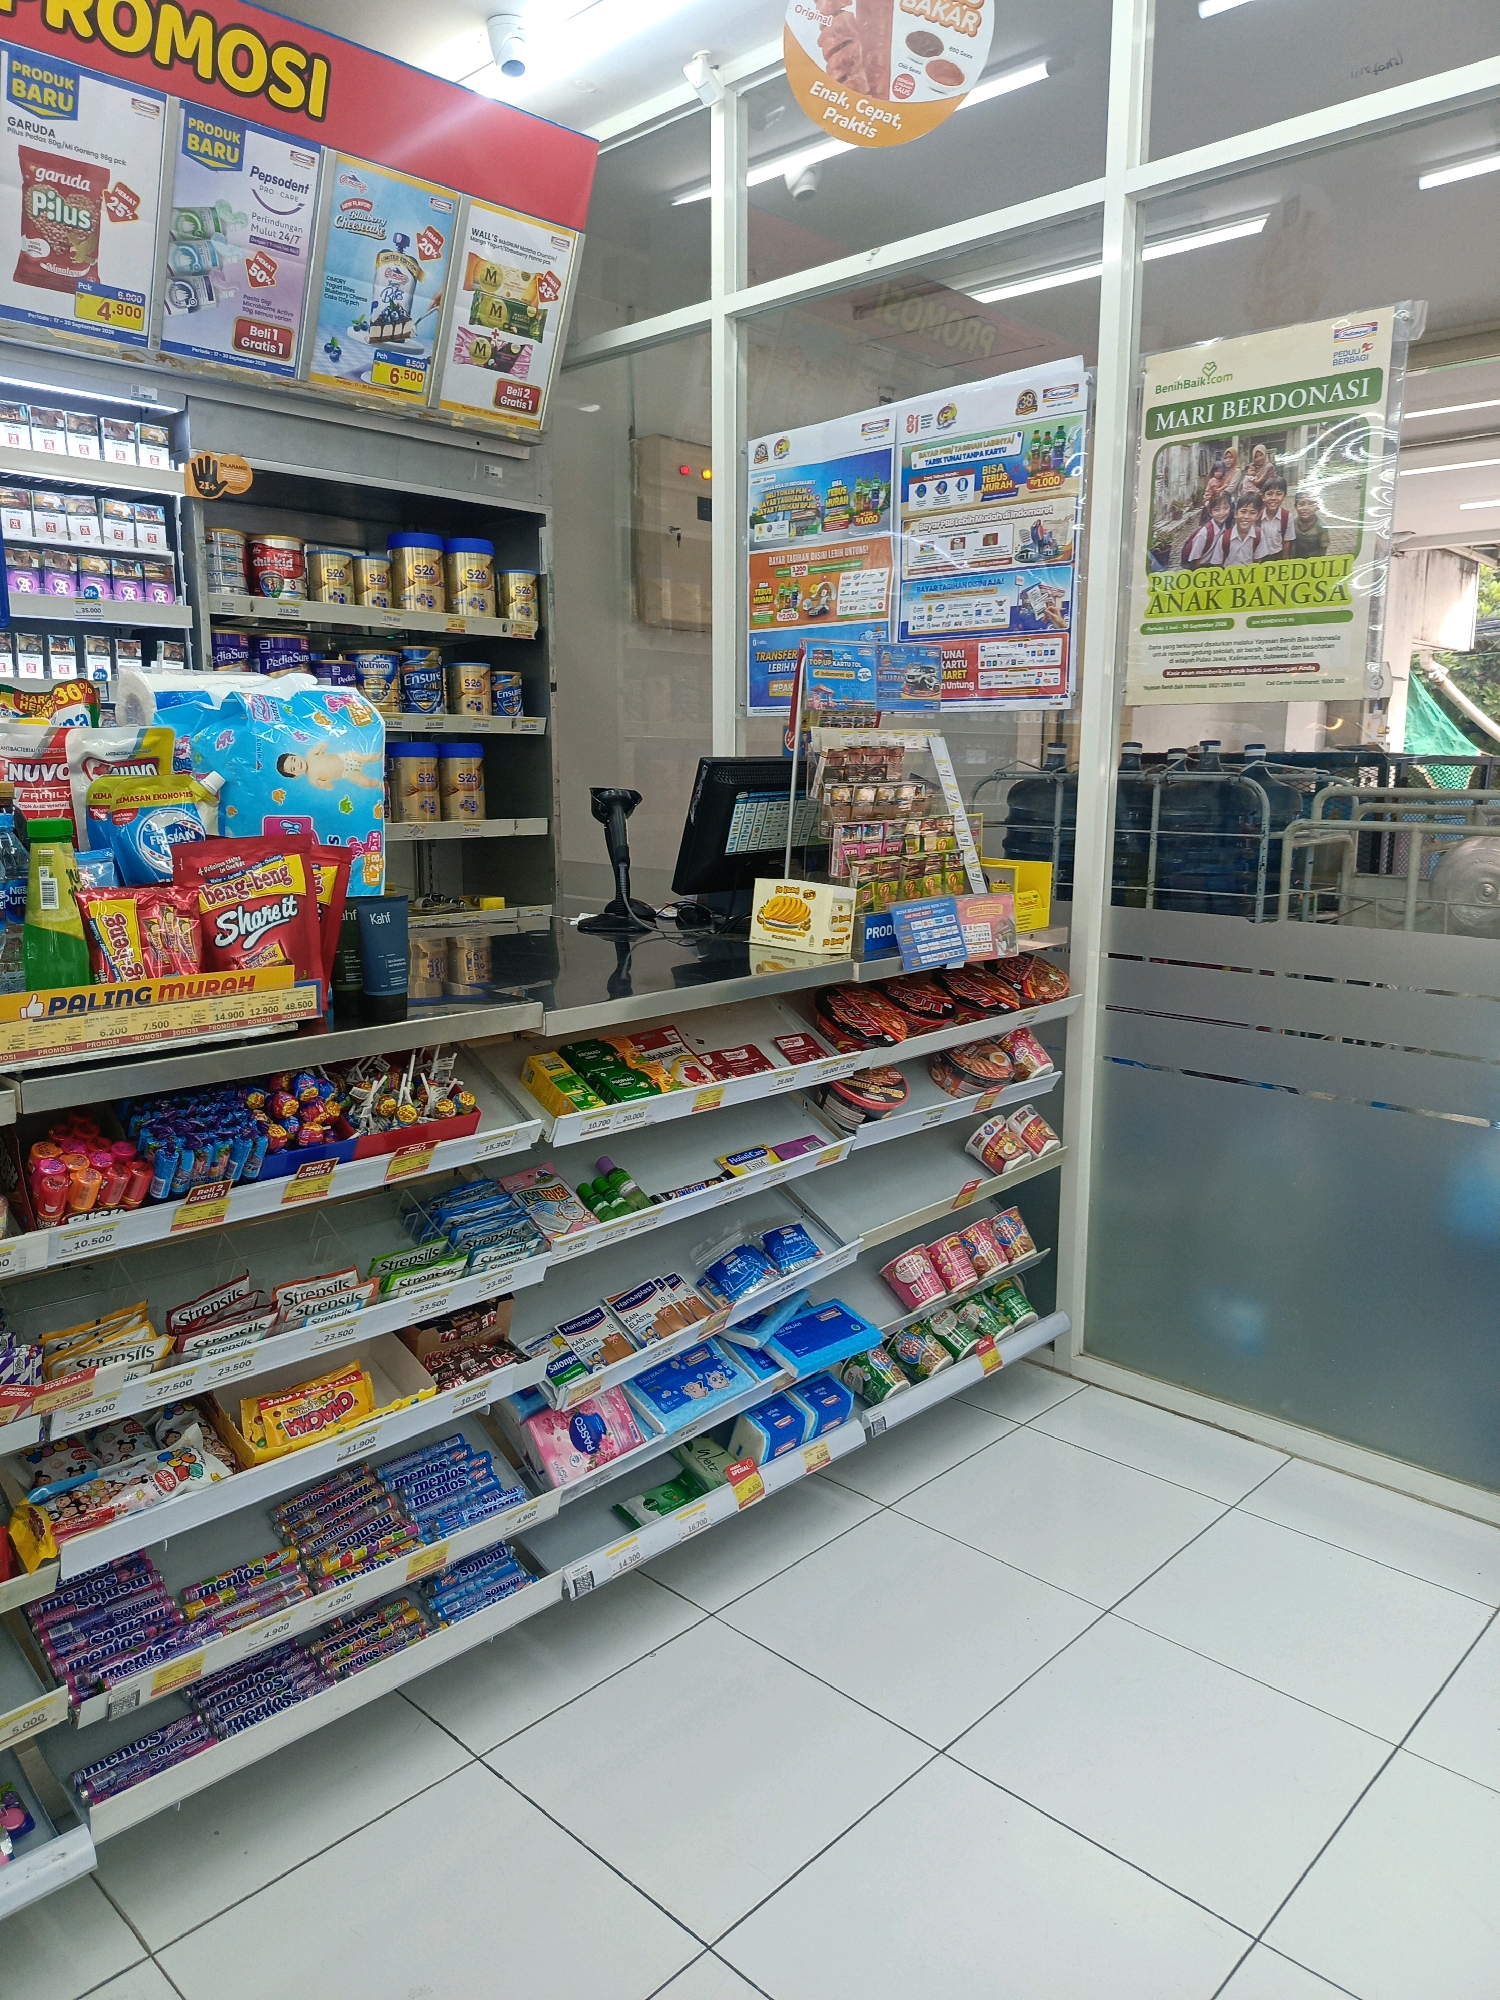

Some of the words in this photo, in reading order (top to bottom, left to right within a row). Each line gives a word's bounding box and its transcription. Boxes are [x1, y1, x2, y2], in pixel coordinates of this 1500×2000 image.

[794, 4, 833, 27] Original
[0, 0, 330, 118] ROMOSI
[12, 60, 75, 92] PRODUK
[11, 78, 75, 113] BARU
[809, 80, 850, 111] Enak,
[855, 98, 903, 131] Cepat,
[7, 116, 57, 138] GARUDA
[188, 117, 242, 145] PRODUK
[822, 106, 879, 139] Praktis
[7, 126, 23, 138] Pilus
[24, 130, 48, 144] Pedas
[74, 144, 99, 161] Goreng
[187, 136, 240, 164] BARU
[35, 165, 91, 193] garuda
[249, 164, 311, 196] Pepsodent
[115, 186, 138, 207] HEMAT
[281, 190, 300, 203] CARE
[105, 197, 135, 220] 25%
[251, 211, 304, 235] Perlindungan
[334, 214, 388, 237] Cheesecake
[350, 210, 388, 228] Blueberry
[251, 223, 276, 239] Mulut
[278, 230, 302, 246] 24/7
[471, 227, 500, 244] WALL'S
[418, 237, 439, 259] 20%
[255, 255, 275, 273] HEMAT
[248, 264, 273, 287] 50%
[78, 281, 92, 293] Pck
[539, 281, 557, 301] 33%
[97, 301, 142, 321] 4.900
[250, 325, 271, 340] Beli
[272, 328, 280, 341] 1
[241, 336, 277, 354] Gratis
[278, 343, 285, 355] 1
[1333, 347, 1361, 359] PEDULI
[376, 352, 388, 361] Pch
[1332, 353, 1369, 367] BERBAGI
[389, 367, 424, 386] 6.500
[1155, 372, 1234, 395] BenihBaik.com
[506, 384, 523, 398] Beli
[523, 388, 531, 400] 2
[500, 395, 527, 410] Gratis
[527, 400, 533, 411] 1
[1154, 403, 1215, 433] MARI
[1220, 377, 1371, 421] BERDONASI
[982, 463, 1004, 475] BISA
[982, 472, 1008, 483] TEBUS
[981, 480, 1013, 493] MURAH
[1151, 567, 1259, 593] PROGRAM
[1263, 558, 1350, 584] PEDULI
[85, 588, 97, 598] 21+
[1148, 588, 1223, 616] ANAK
[1230, 580, 1349, 610] BANGSA
[266, 651, 311, 671] PediaSure
[756, 650, 798, 662] TRANSFER
[94, 671, 107, 681] 21+
[768, 663, 793, 673] LEBIH
[404, 672, 441, 686] Ensure
[946, 680, 975, 692] Untung
[54, 681, 93, 704] 30%
[497, 689, 522, 699] Ensure
[8, 762, 70, 783] NUVO
[22, 791, 72, 800] FAMILY
[116, 793, 151, 805] KEMASAN
[152, 790, 194, 802] EKONOMIS
[150, 831, 196, 847] FRISIAN
[200, 864, 295, 907] beng-beng
[214, 902, 281, 949] Share
[281, 894, 299, 918] it
[341, 910, 358, 922] ahf
[369, 912, 392, 926] Kahf
[865, 927, 897, 940] PROD
[48, 986, 153, 1016] PALING
[157, 975, 257, 1003] MURAH
[249, 1005, 280, 1017] 12.900
[284, 999, 314, 1011] 48.500
[214, 1010, 245, 1022] 14.900
[99, 1026, 128, 1038] 6.200
[142, 1020, 170, 1032] 7.500
[37, 1045, 74, 1056] PROMOSI
[86, 1038, 120, 1049] PROMOSI
[588, 1117, 612, 1131] 10.700
[622, 1111, 645, 1125] 20.000
[484, 1138, 511, 1153] 15.300
[189, 1191, 218, 1203] Gratis
[197, 1186, 216, 1197] Beli
[519, 1188, 543, 1205] KOOL
[543, 1184, 569, 1201] FEVER
[677, 1182, 708, 1198] SNICKERS
[182, 1218, 216, 1229] PROMOSI
[74, 1234, 113, 1251] 10.500
[566, 1241, 588, 1252] 8.500
[380, 1247, 440, 1272] Strepsils
[486, 1273, 513, 1289] 23.500
[179, 1287, 244, 1325] Strepsils
[419, 1298, 448, 1314] 23.500
[616, 1285, 655, 1311] Hansaplast
[562, 1311, 603, 1334] Hansaplast
[623, 1312, 640, 1325] KAIN
[627, 1312, 653, 1330] ELASTIS
[323, 1328, 355, 1343] 23.500
[570, 1337, 587, 1348] KAIN
[574, 1337, 600, 1353] ELASTIS
[217, 1359, 252, 1377] 23.500
[547, 1355, 578, 1374] Salonpa
[650, 1366, 668, 1380] WAJAH
[156, 1378, 194, 1396] 27.500
[462, 1390, 487, 1406] 10.200
[77, 1403, 116, 1422] 23.500
[283, 1391, 355, 1438] CHACHA
[576, 1416, 595, 1452] PASEO
[346, 1437, 376, 1454] 11.900
[731, 1466, 750, 1477] SPESIAL
[413, 1477, 468, 1507] mentos
[286, 1489, 326, 1515] mentos
[516, 1510, 538, 1525] 4.900
[688, 1517, 708, 1532] 16.700
[618, 1552, 641, 1570] 14.300
[198, 1563, 266, 1598] mentos
[41, 1573, 118, 1614] mentos
[327, 1593, 353, 1609] 4.900
[263, 1623, 290, 1640] 4.900
[66, 1629, 146, 1673] mentos
[161, 1674, 197, 1691] PROMOSI
[217, 1675, 285, 1715] mentos
[12, 1713, 46, 1734] 5.000
[149, 1728, 206, 1760] mentos
[84, 1730, 162, 1780] mentos
